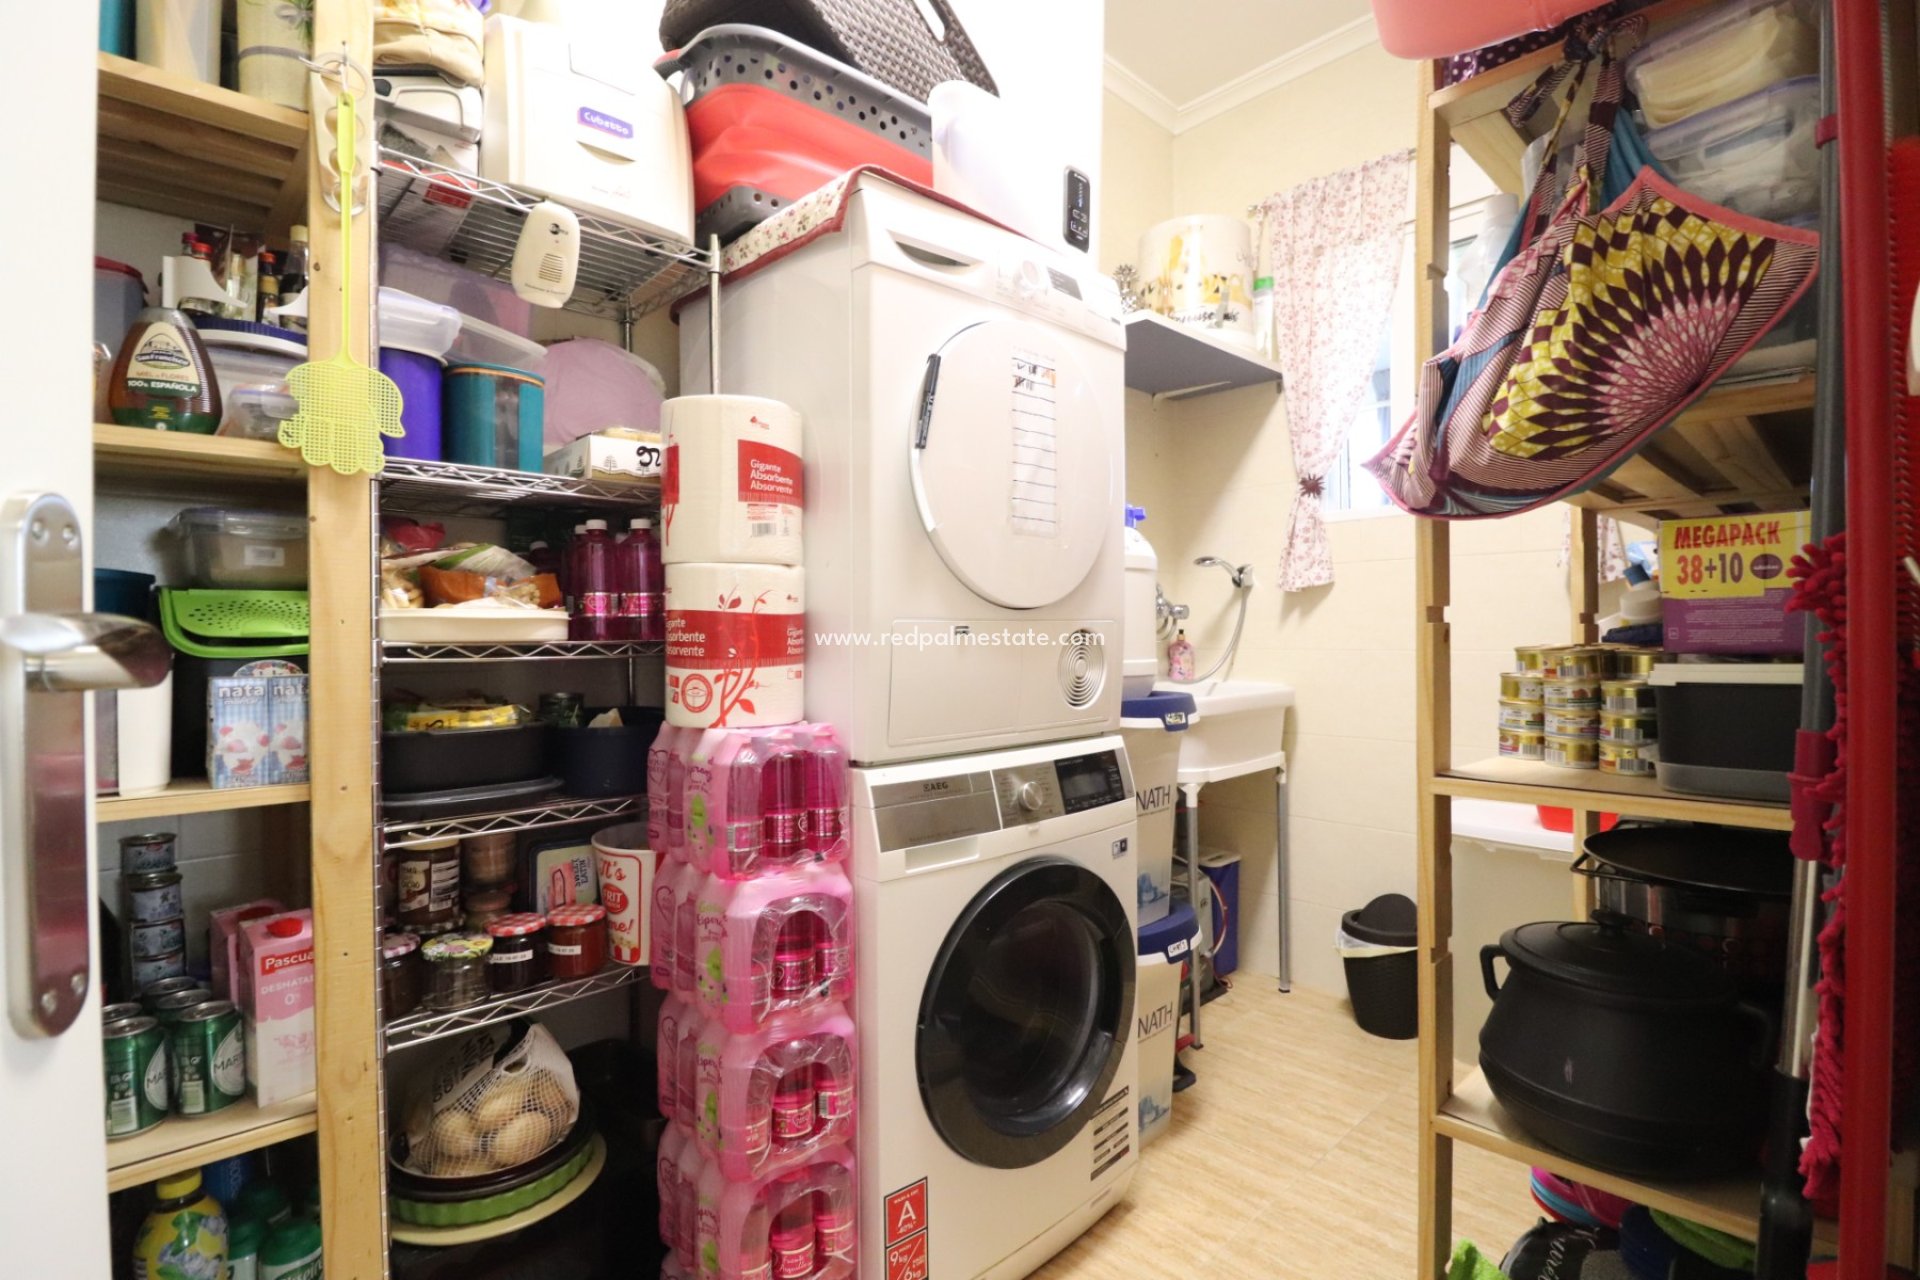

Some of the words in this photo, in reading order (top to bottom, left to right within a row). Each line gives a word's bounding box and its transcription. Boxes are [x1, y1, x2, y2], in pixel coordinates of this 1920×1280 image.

[150, 380, 197, 393] ESPAÑOLA
[750, 459, 781, 473] Gigante
[750, 469, 794, 486] Absorbente
[750, 480, 794, 495] Absorvente
[1674, 521, 1781, 549] MEGAPACK
[1677, 552, 1743, 585] 38+10
[219, 684, 265, 698] nata
[1136, 784, 1171, 810] NATH
[1138, 1001, 1173, 1038] NATH
[898, 1200, 917, 1228] A
